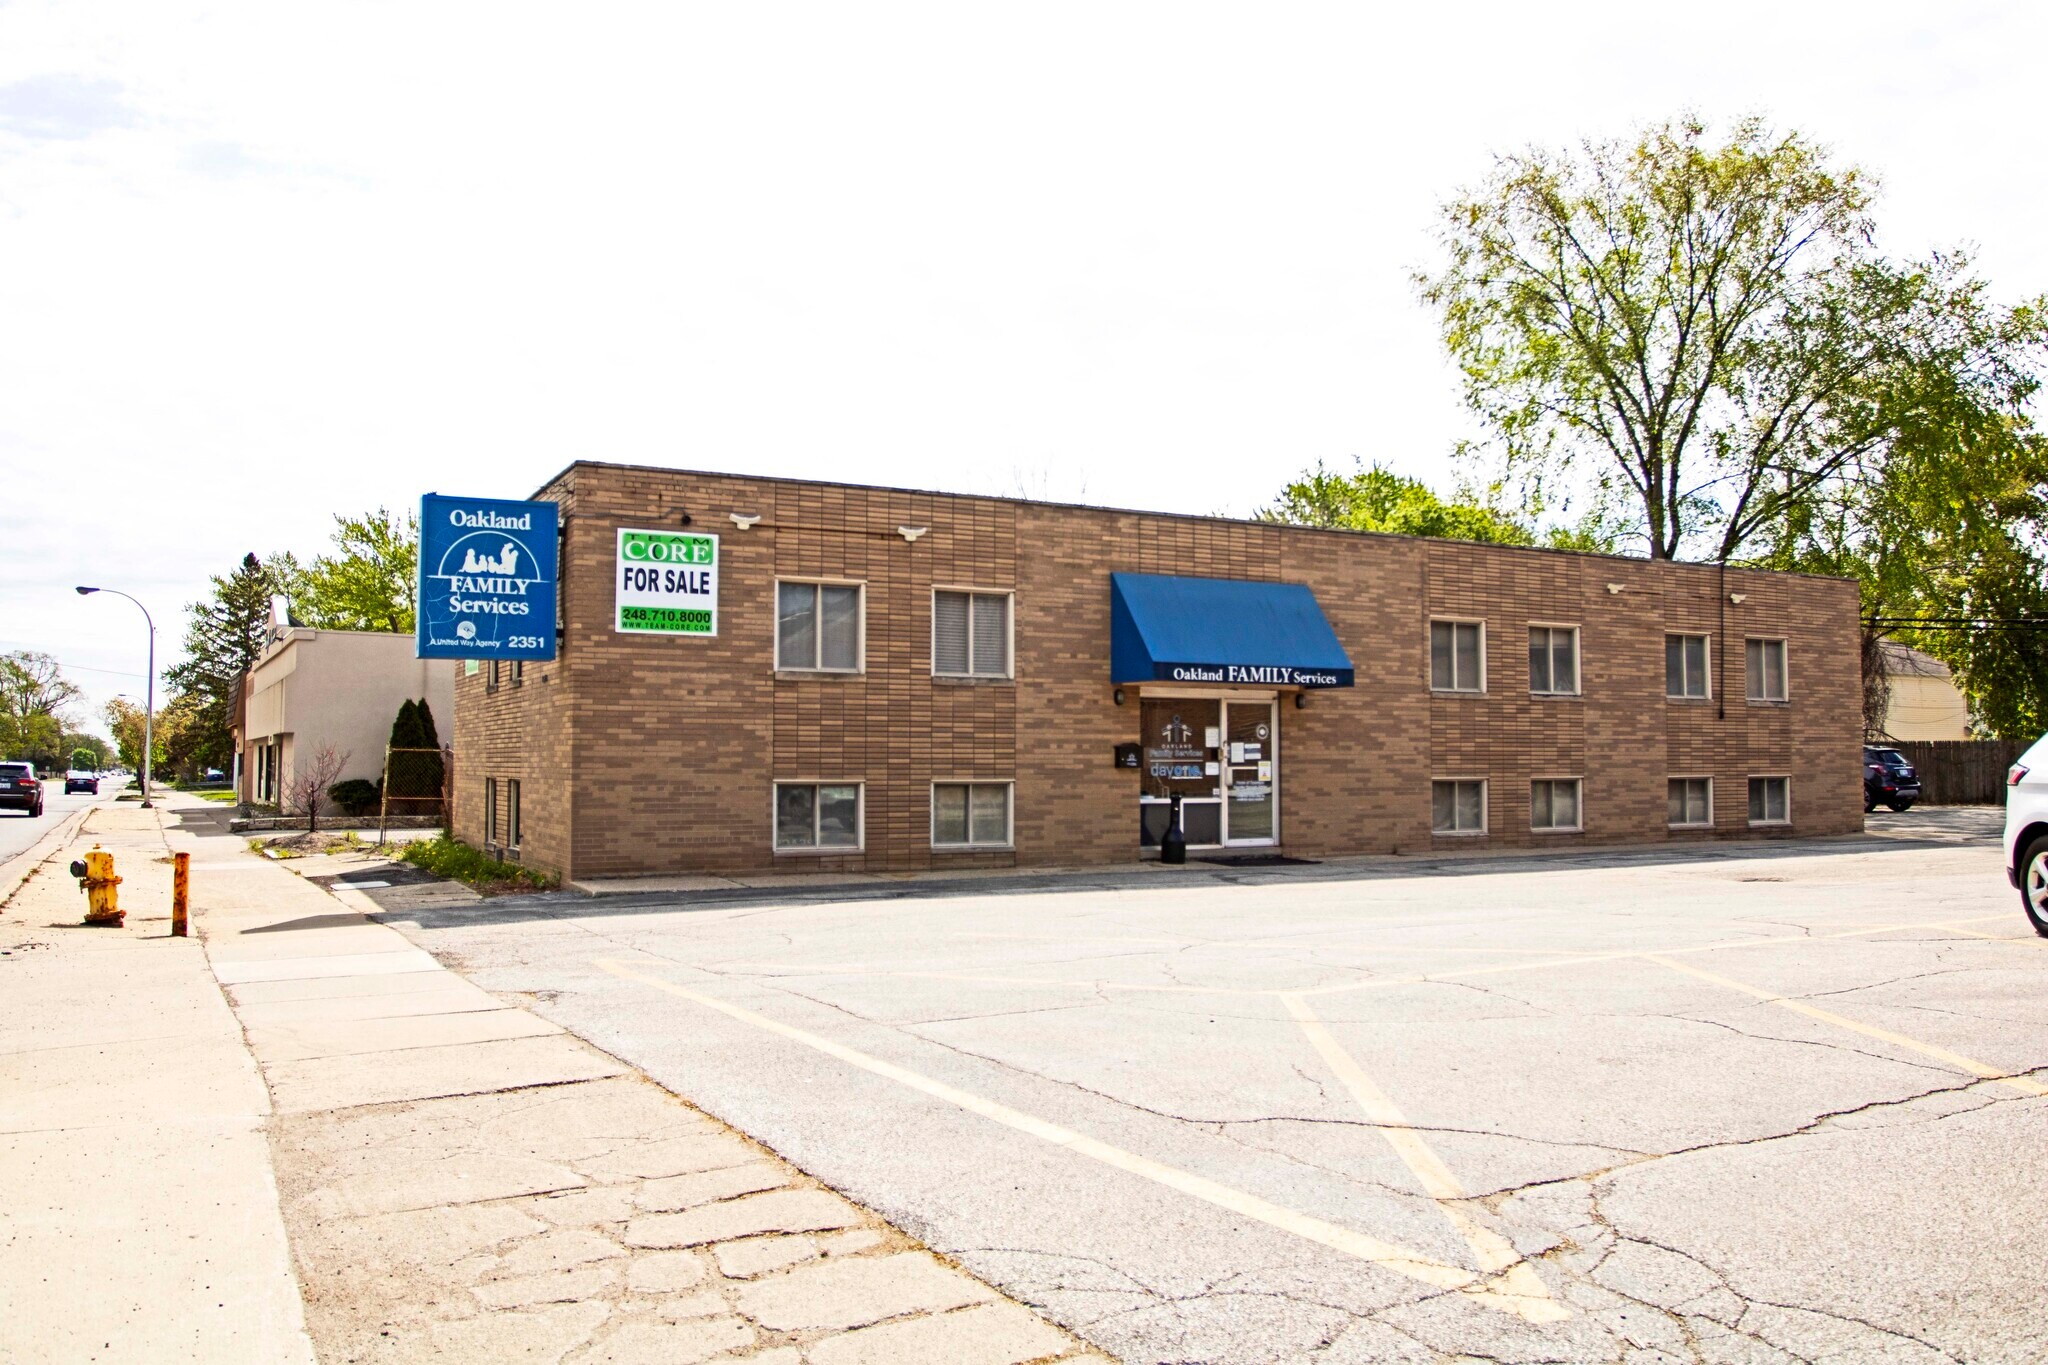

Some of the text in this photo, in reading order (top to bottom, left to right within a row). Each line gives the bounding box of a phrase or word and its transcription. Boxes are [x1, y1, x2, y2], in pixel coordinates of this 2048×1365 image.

[449, 509, 531, 530] Oakland
[626, 533, 710, 545] TEAM
[624, 541, 710, 564] CORE
[449, 576, 532, 595] FAMILY
[623, 567, 710, 595] FOR SALE
[449, 595, 529, 615] Services
[622, 608, 711, 623] 248.710.8000
[437, 638, 459, 646] United
[460, 639, 475, 648] Way
[475, 639, 500, 649] Agency
[508, 636, 545, 649] 2351
[1173, 666, 1337, 685] Oakland FAMILY Services
